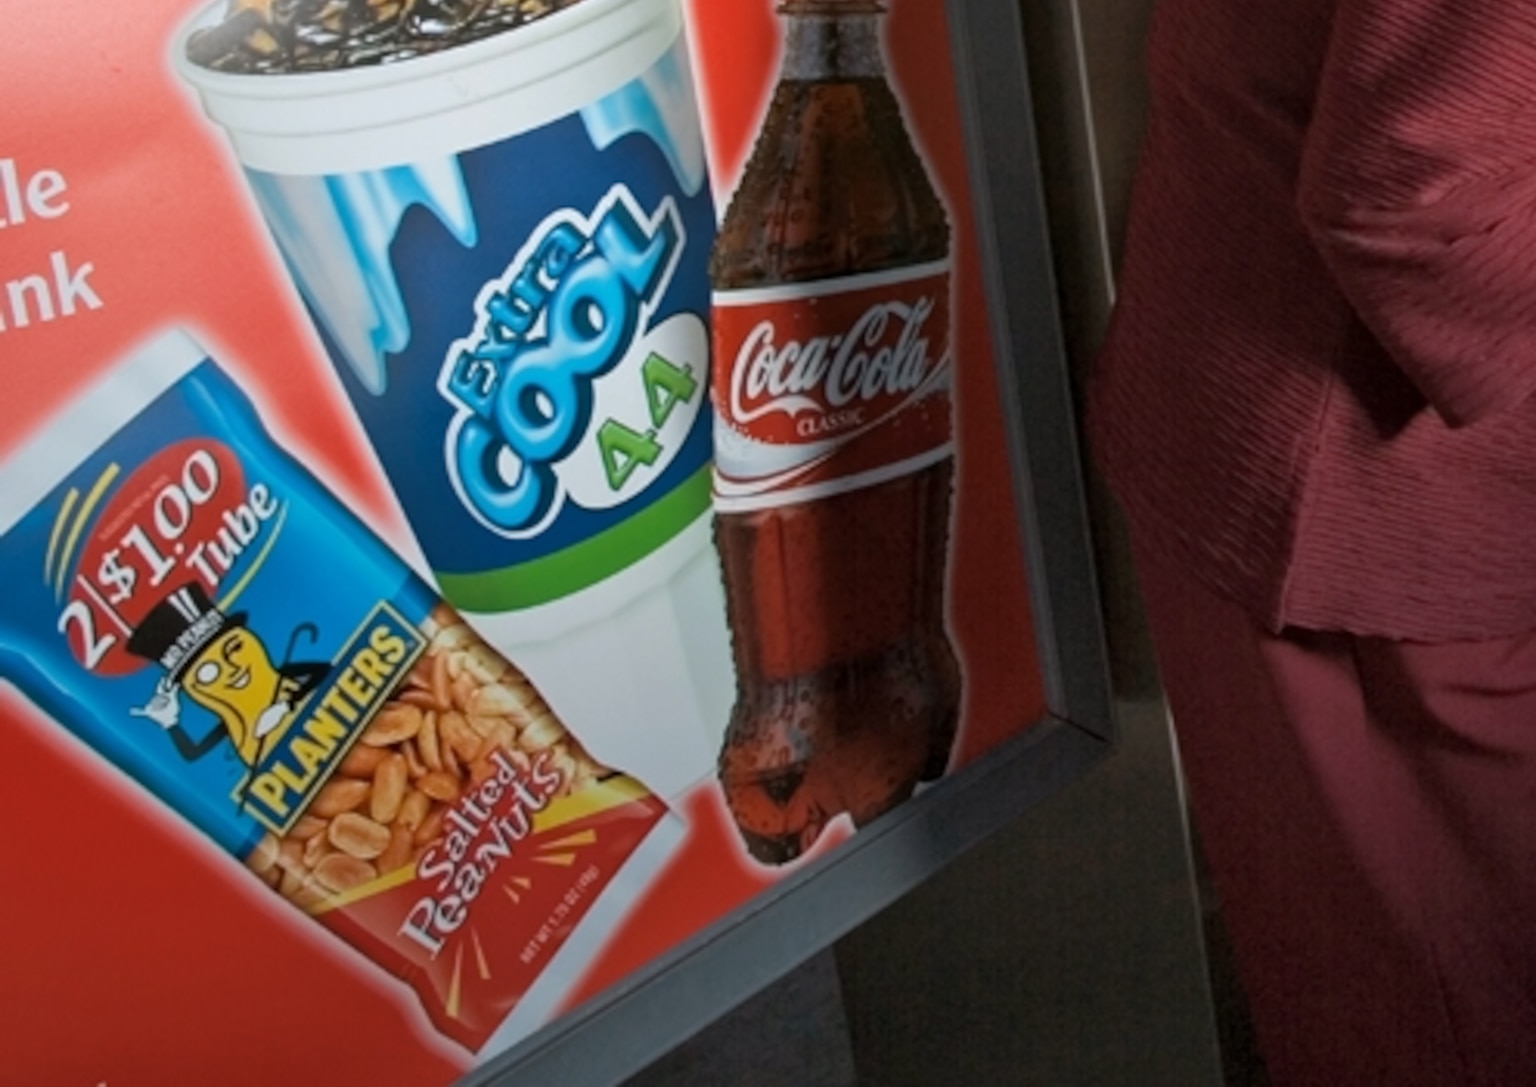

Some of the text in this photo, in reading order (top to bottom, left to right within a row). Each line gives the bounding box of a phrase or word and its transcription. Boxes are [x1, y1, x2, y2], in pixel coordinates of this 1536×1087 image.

[449, 220, 592, 419] Extra
[457, 197, 685, 532] COOL
[596, 351, 700, 492] 44
[796, 406, 866, 438] CLASSIC
[185, 482, 280, 588] Tube
[250, 625, 410, 818] PLANTERS
[417, 750, 518, 894] Salted
